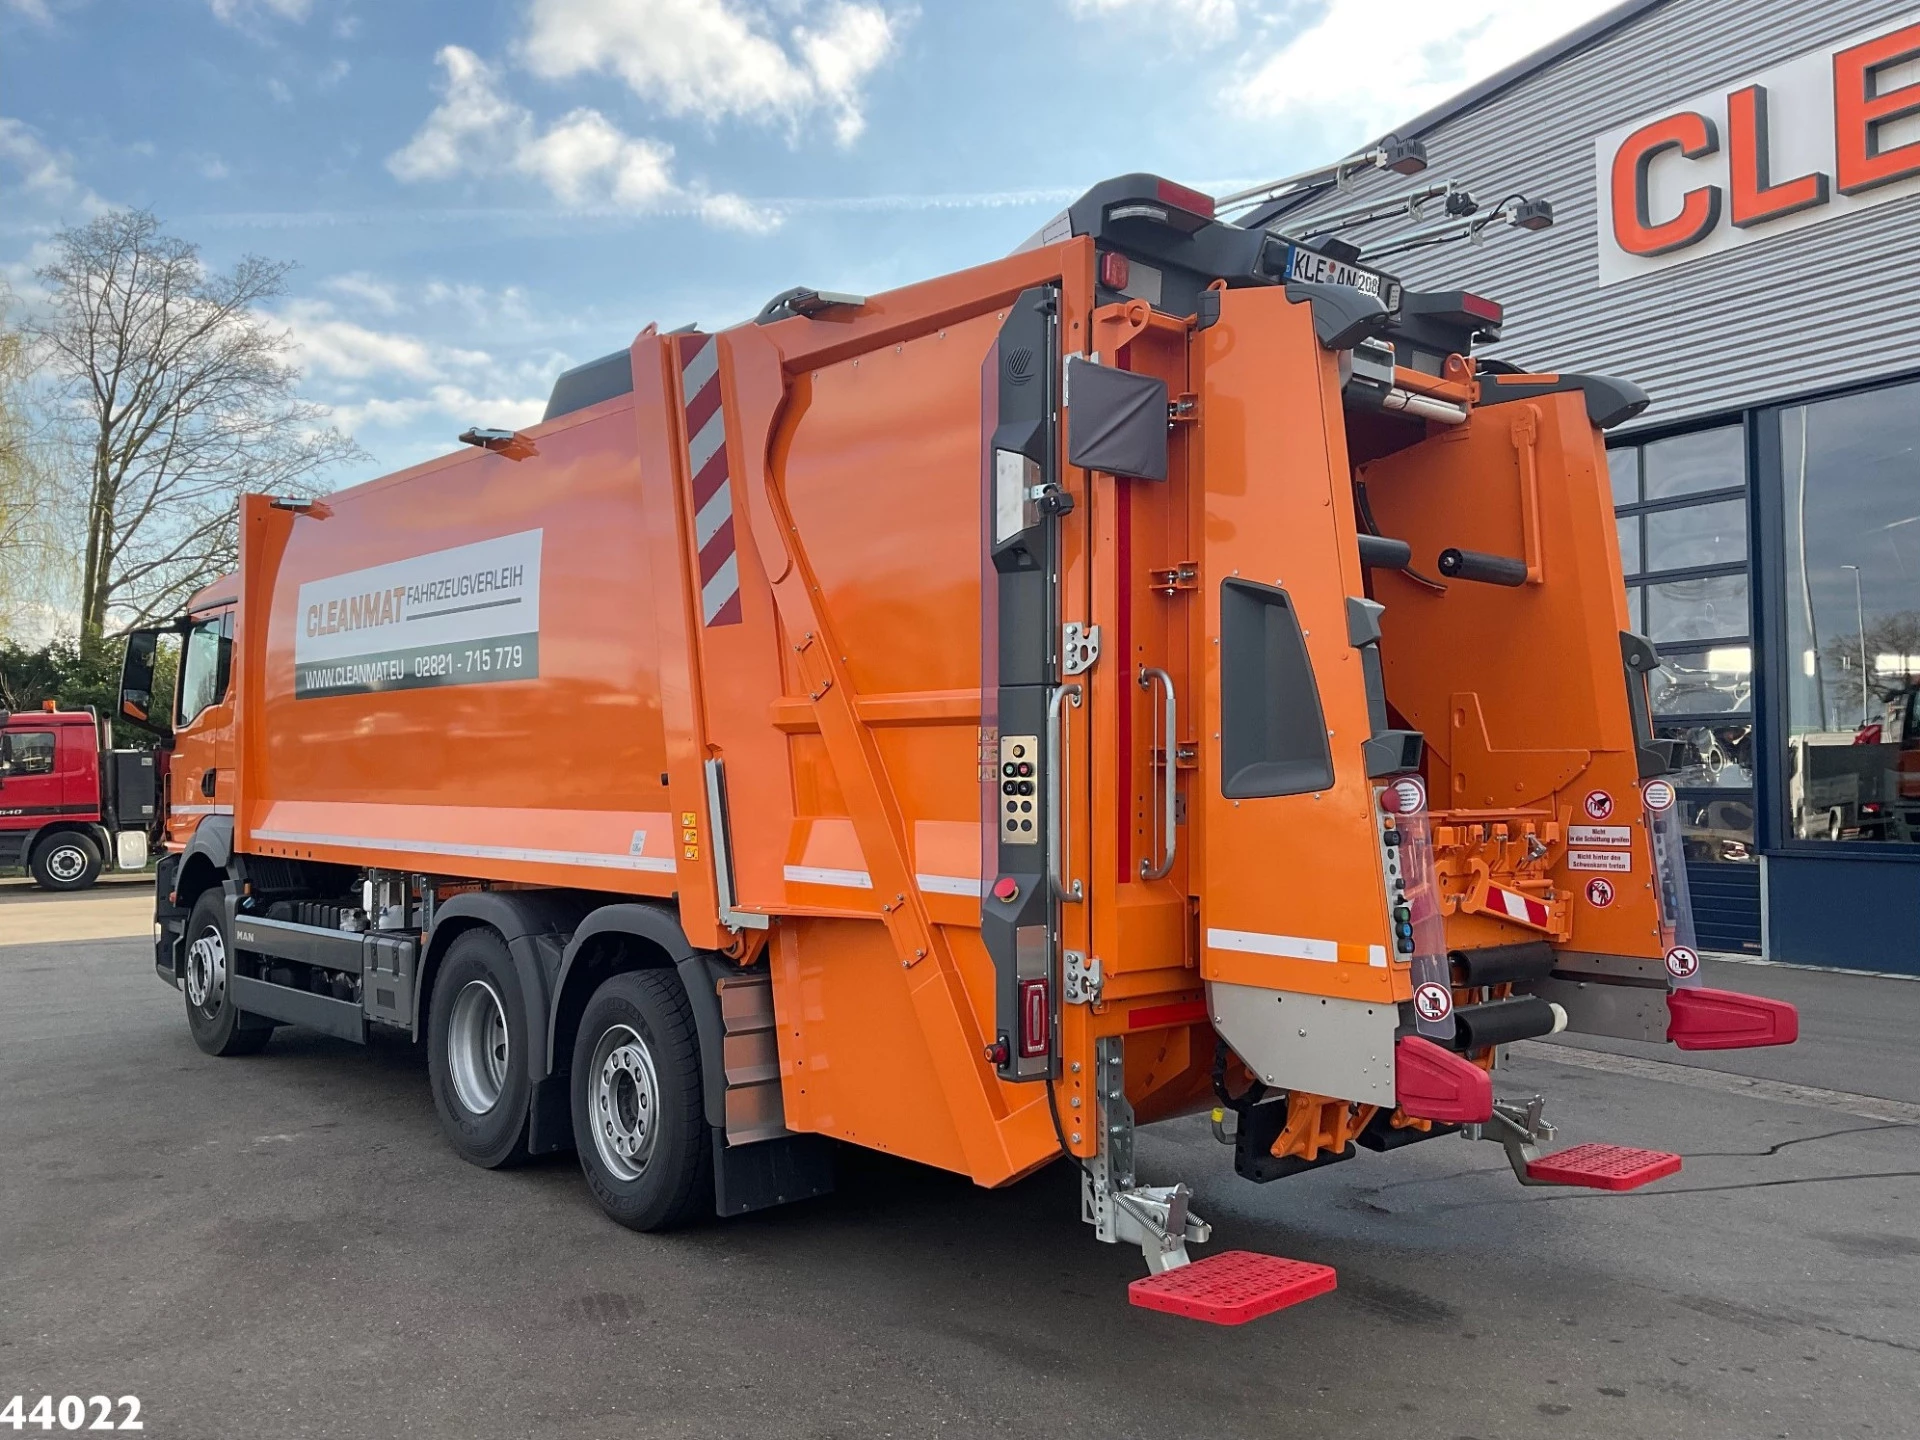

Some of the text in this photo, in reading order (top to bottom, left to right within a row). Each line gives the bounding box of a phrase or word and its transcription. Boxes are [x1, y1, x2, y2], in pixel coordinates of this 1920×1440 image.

[1611, 21, 1920, 258] CLE
[1293, 251, 1327, 283] KLE
[306, 564, 523, 638] CLEANMAT FAHRZEUGVERLEIH
[305, 659, 404, 689] WWW.CLEANMAT.EU
[414, 653, 453, 678] 02821
[465, 650, 491, 673] 715
[496, 645, 523, 669] 779
[1611, 836, 1630, 844] greifen
[1593, 853, 1609, 861] hinter
[236, 930, 255, 943] MAN
